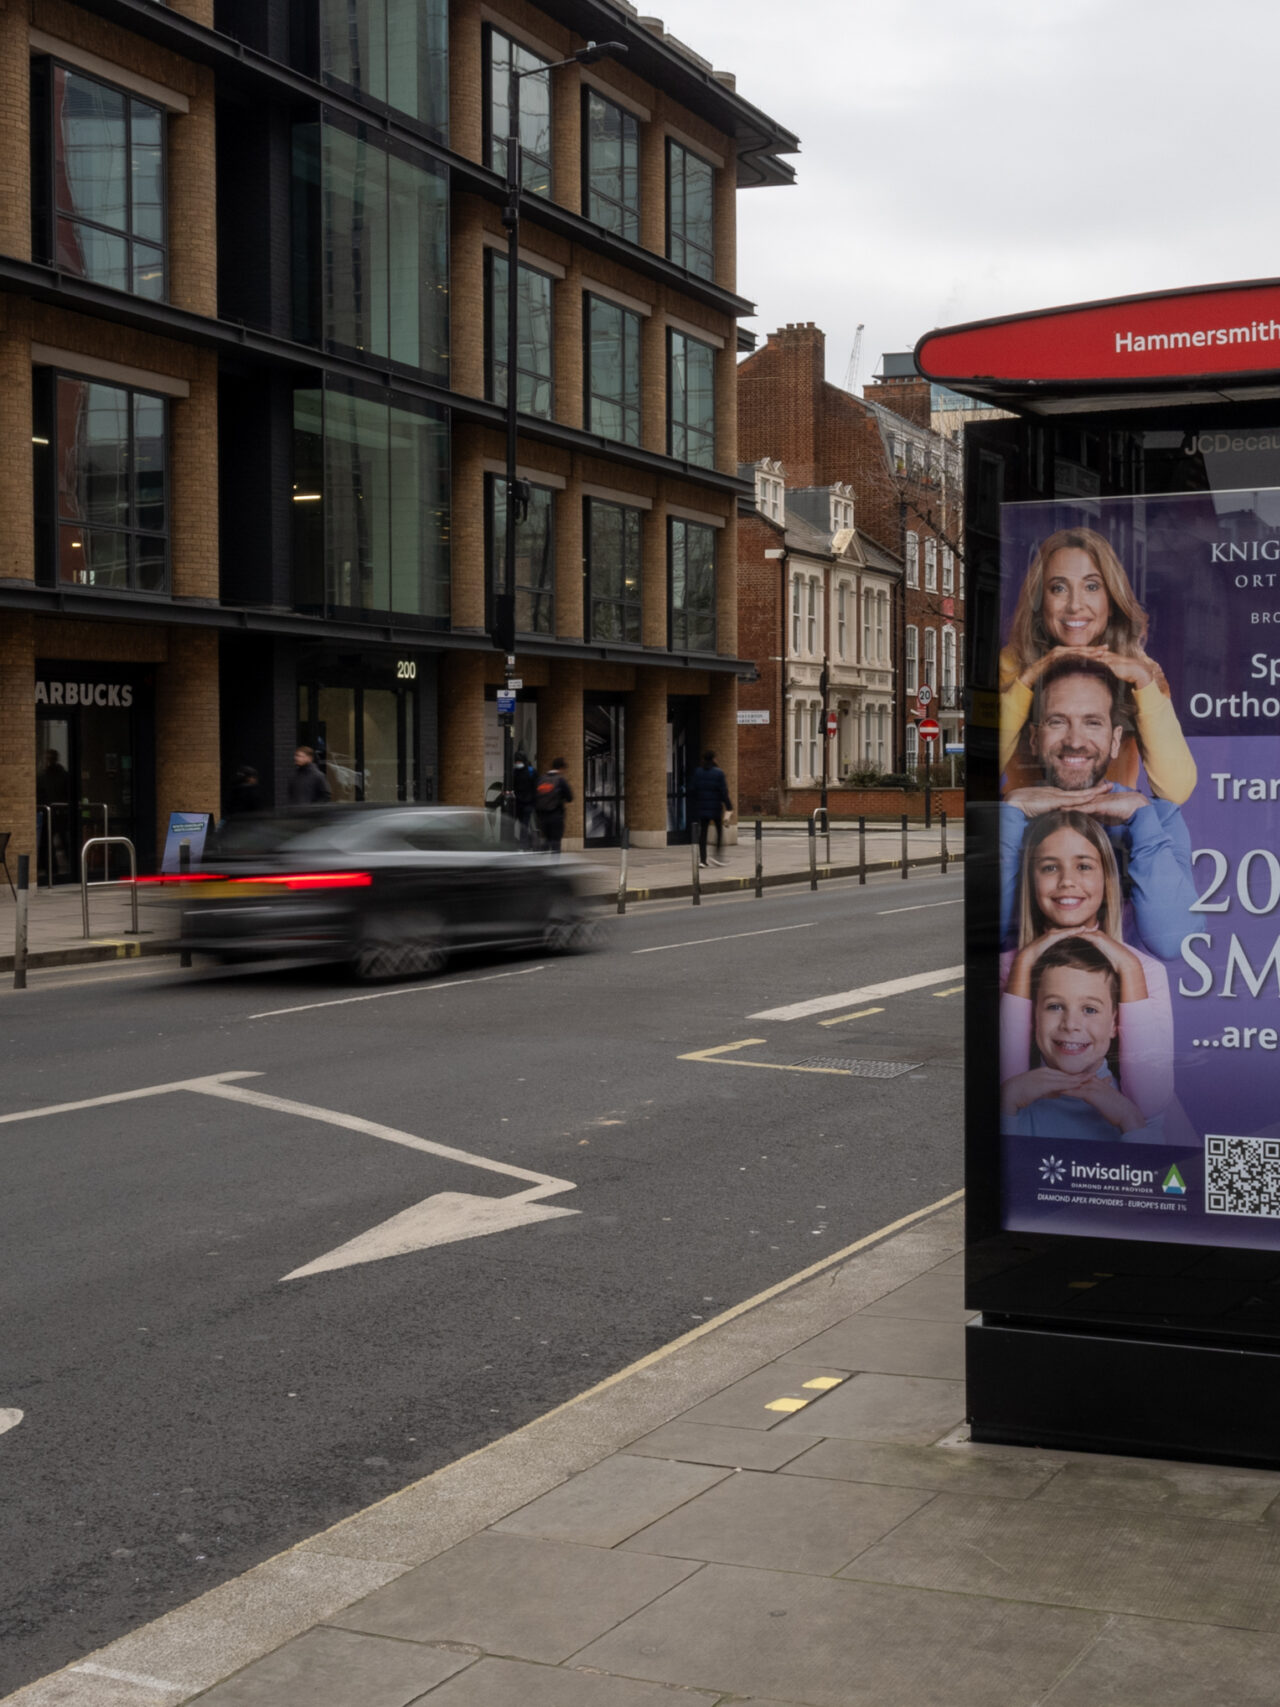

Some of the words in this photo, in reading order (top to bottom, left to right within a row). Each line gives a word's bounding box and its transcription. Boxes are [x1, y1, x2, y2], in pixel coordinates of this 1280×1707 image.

[397, 661, 416, 679] 200
[920, 691, 931, 700] 20
[1071, 1161, 1153, 1186] invisalign
[1037, 1193, 1070, 1203] DIAMOND
[1071, 1195, 1087, 1204] APEX
[1089, 1196, 1124, 1207] PROVIDERS
